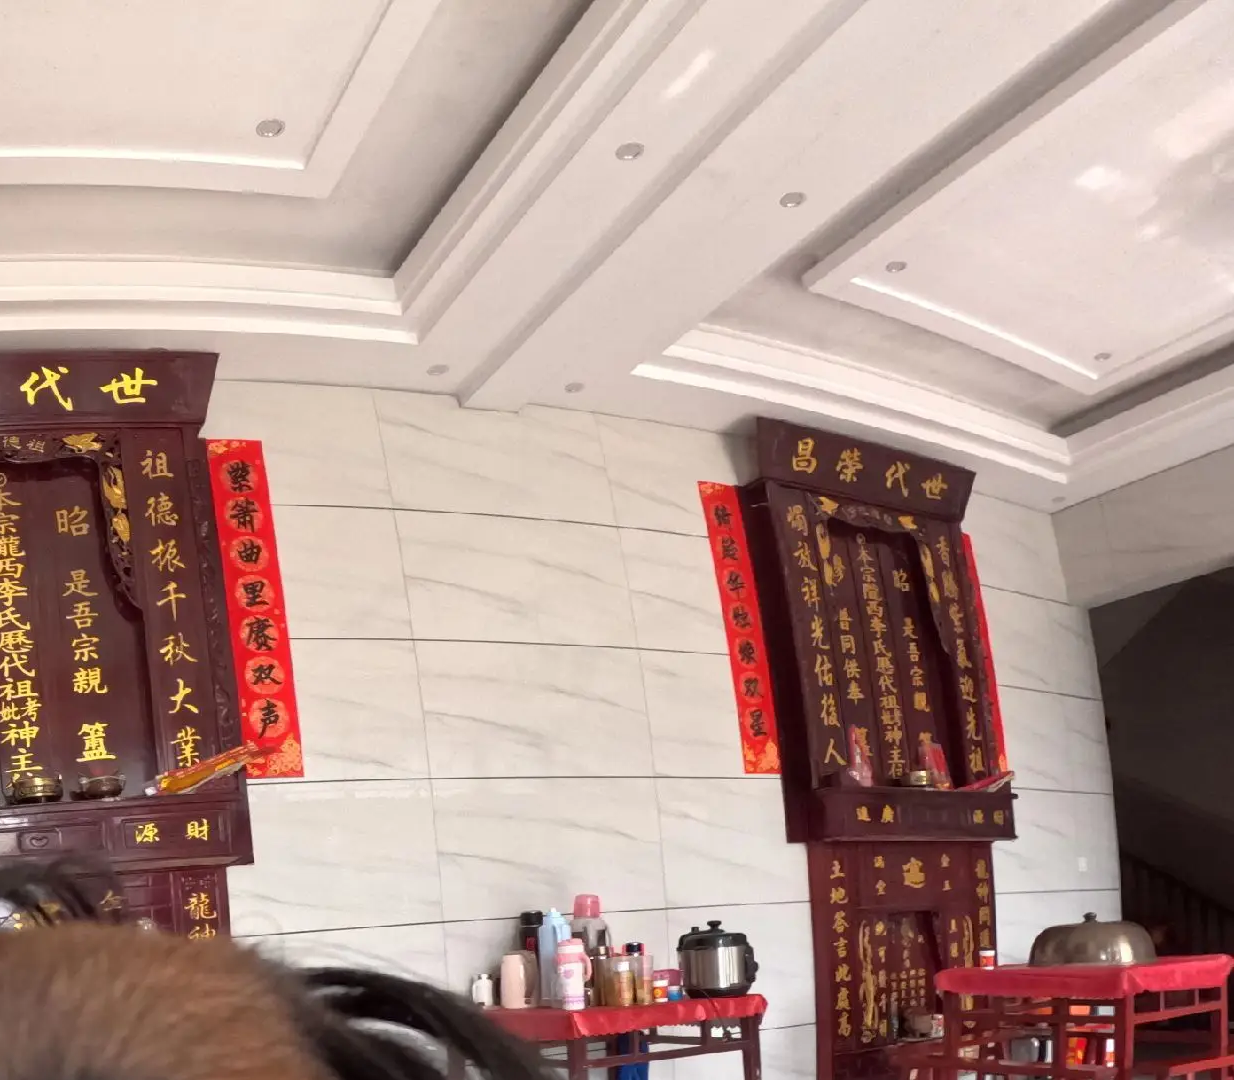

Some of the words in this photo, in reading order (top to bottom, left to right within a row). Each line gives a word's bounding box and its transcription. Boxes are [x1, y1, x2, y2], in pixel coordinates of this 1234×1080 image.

[55, 505, 90, 537] 昭
[62, 569, 108, 694] 是吾宗親
